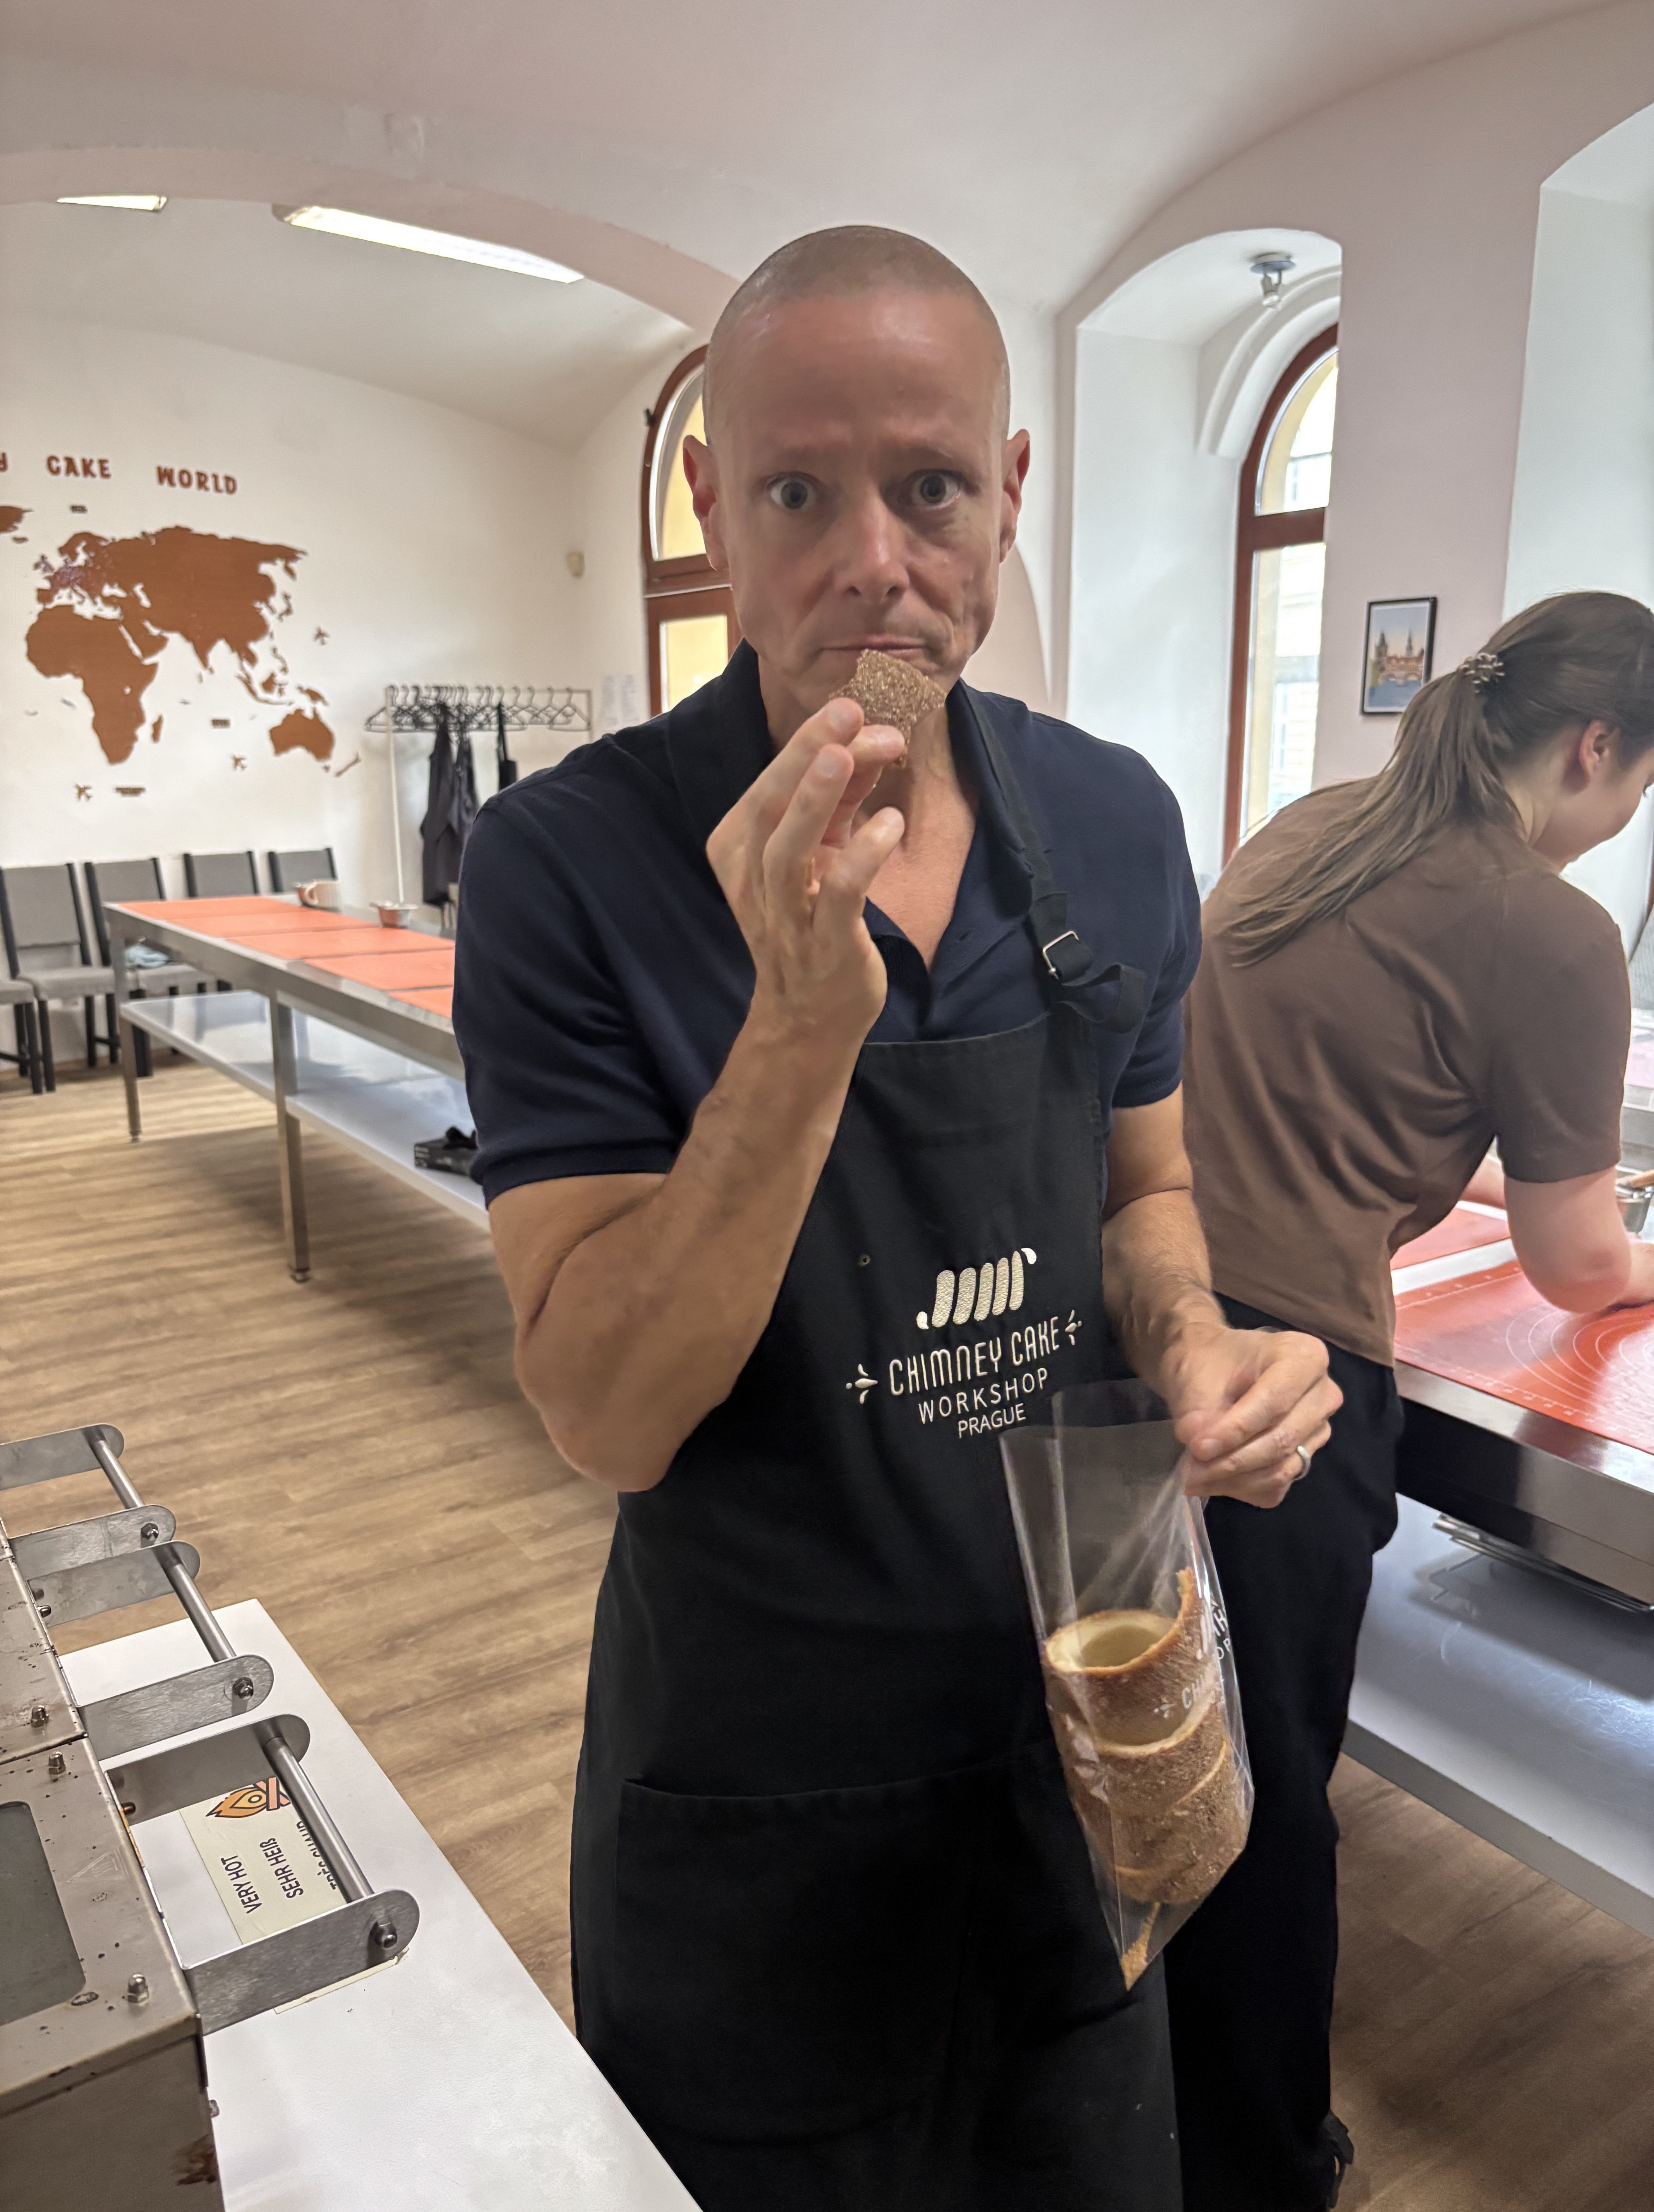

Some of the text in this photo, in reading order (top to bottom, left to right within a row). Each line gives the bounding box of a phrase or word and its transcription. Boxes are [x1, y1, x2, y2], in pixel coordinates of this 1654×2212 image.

[46, 455, 237, 495] CAKE WORLD
[889, 1316, 1060, 1395] CHIMNEY CAKE
[918, 1367, 1048, 1424] WORKSHOP
[958, 1403, 1026, 1439] PRAGUE
[221, 1855, 262, 1914] VERY HOT
[274, 1865, 304, 1898] SEHR
